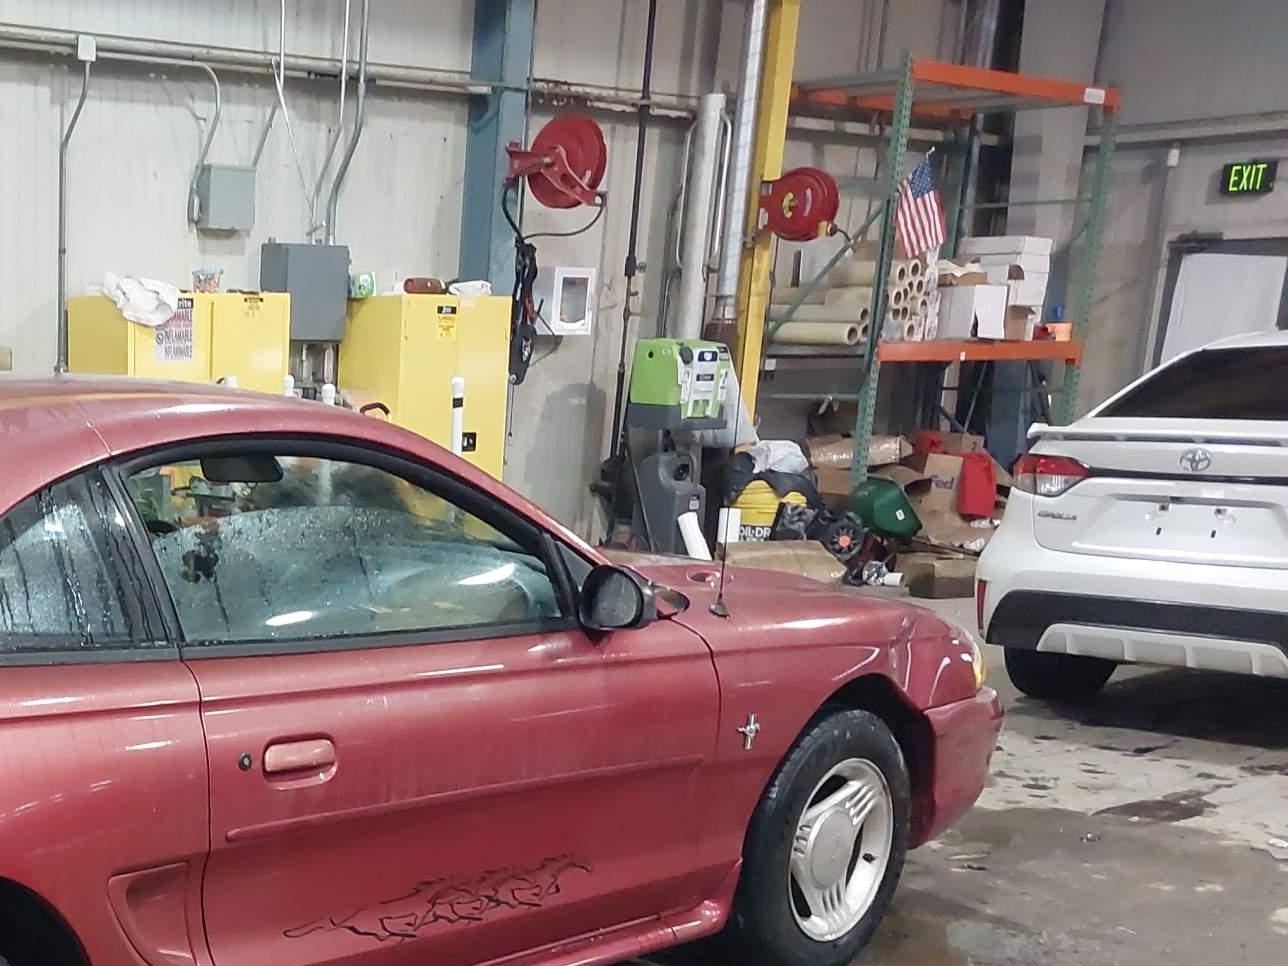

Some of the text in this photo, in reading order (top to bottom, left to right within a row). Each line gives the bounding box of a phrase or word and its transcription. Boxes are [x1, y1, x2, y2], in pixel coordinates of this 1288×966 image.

[1228, 163, 1268, 192] EXIT
[178, 298, 193, 309] rite
[738, 525, 772, 538] OIL-DR
